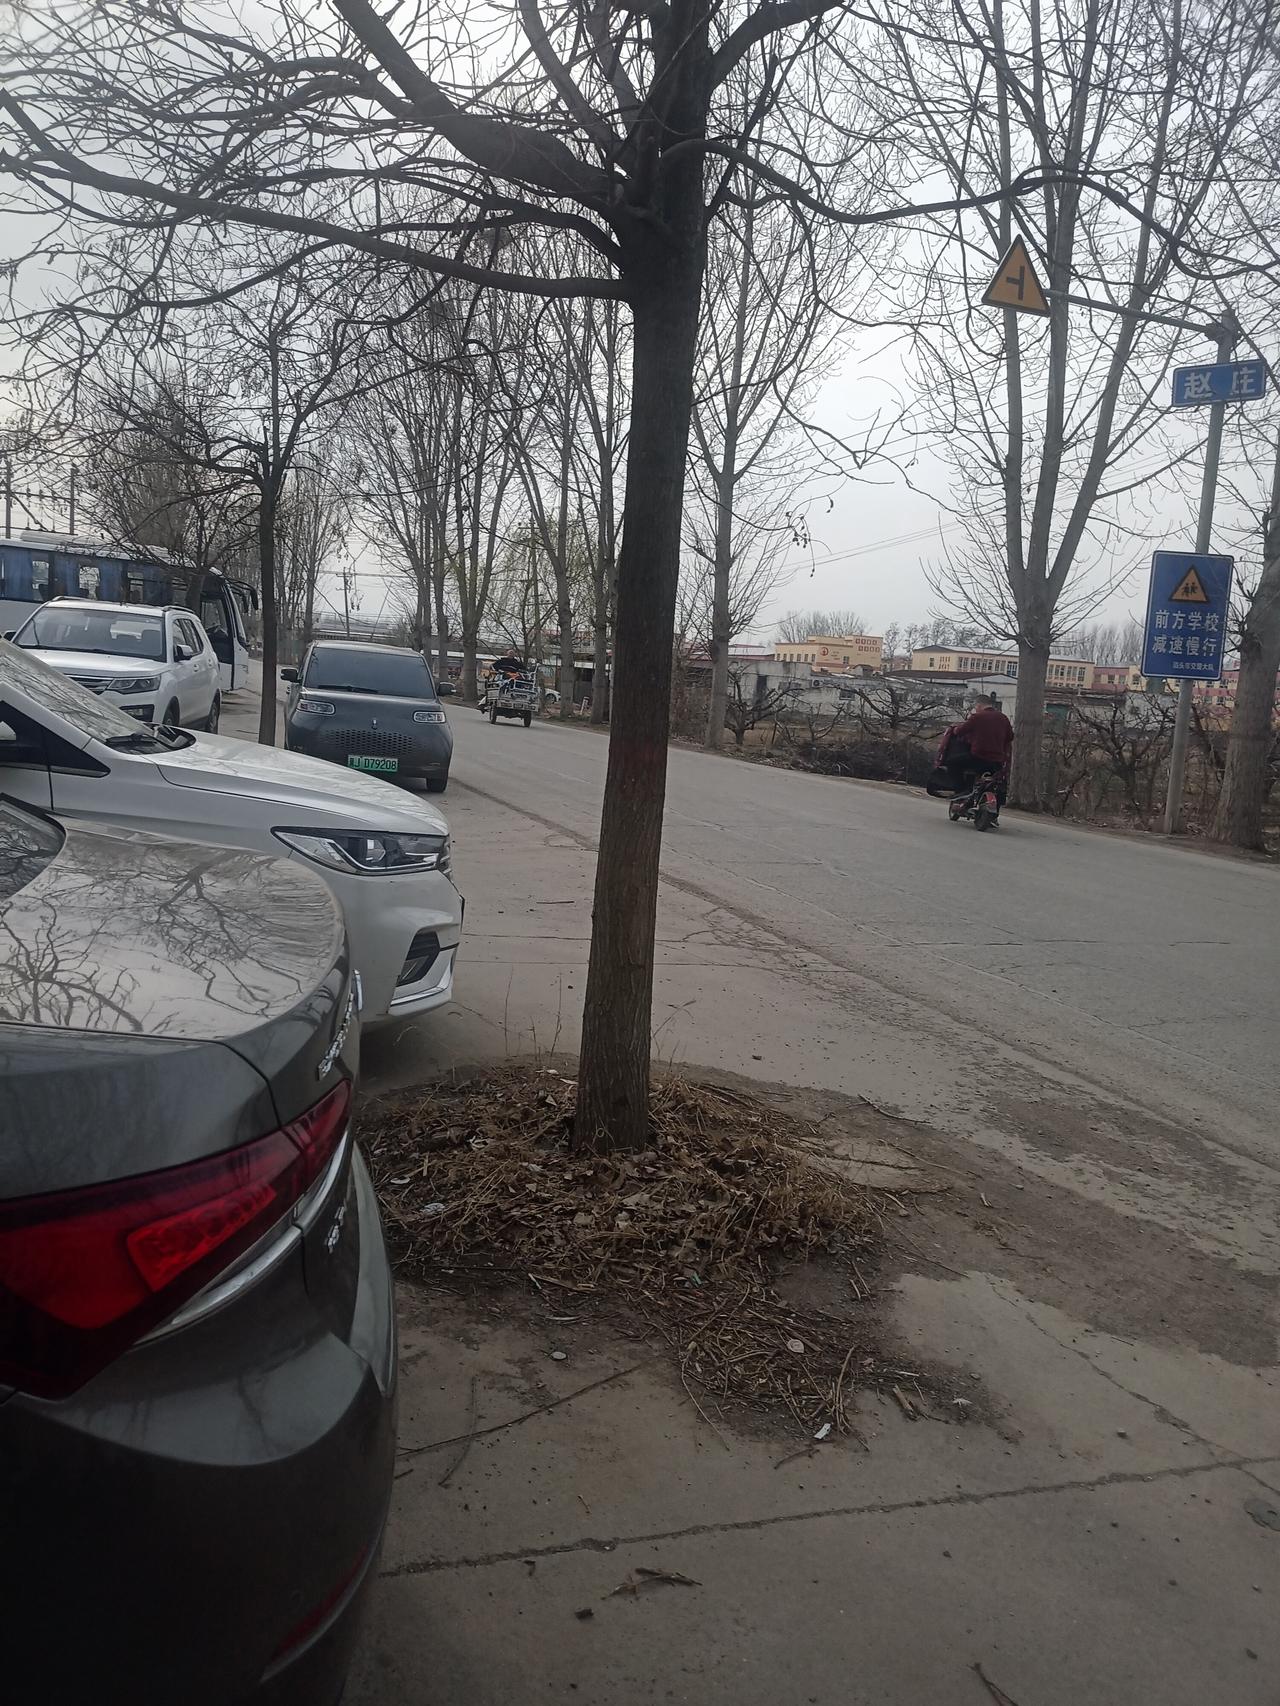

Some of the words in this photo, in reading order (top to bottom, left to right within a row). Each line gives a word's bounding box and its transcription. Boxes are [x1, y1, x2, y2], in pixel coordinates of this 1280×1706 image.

[1183, 366, 1256, 399] 赵庄
[1155, 609, 1219, 632] 前方学校
[1152, 635, 1217, 656] 减速慢行
